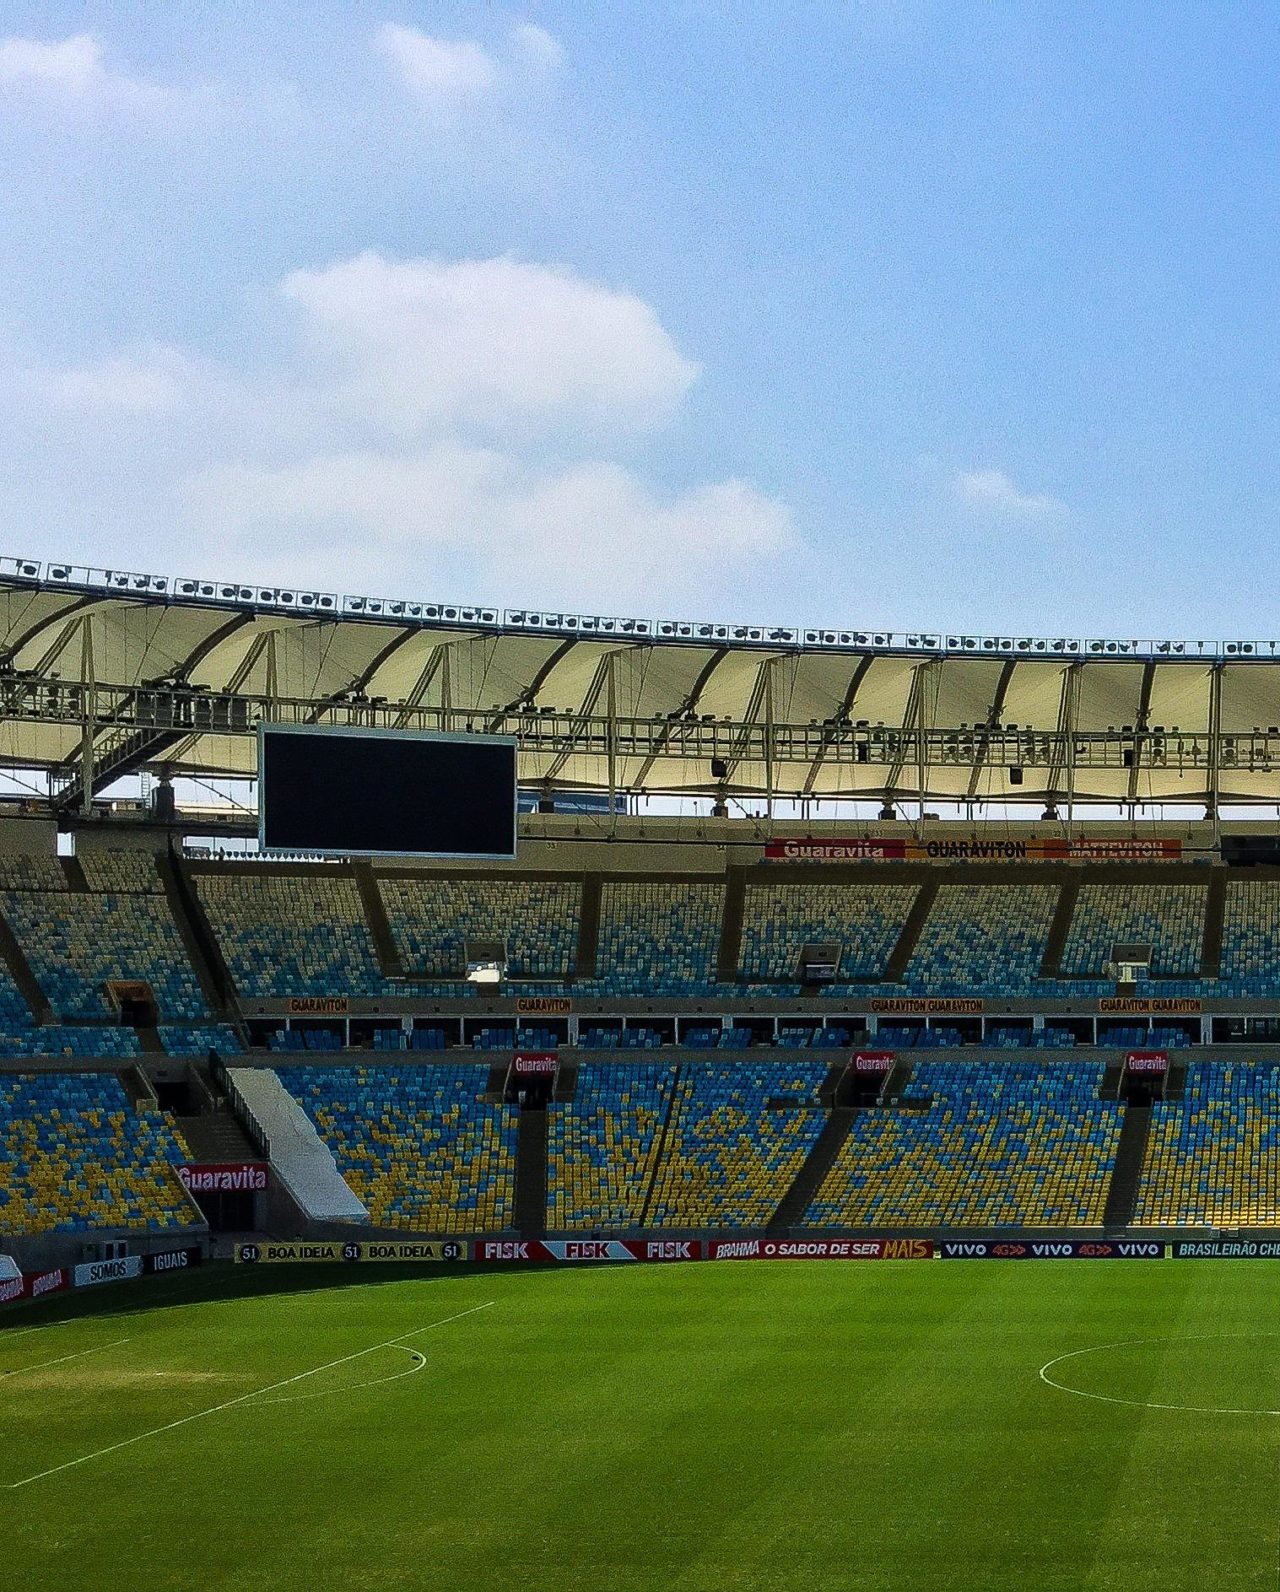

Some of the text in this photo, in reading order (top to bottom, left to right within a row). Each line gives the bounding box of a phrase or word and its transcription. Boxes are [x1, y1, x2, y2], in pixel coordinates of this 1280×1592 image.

[783, 840, 884, 858] Guaravita
[926, 840, 1026, 858] GUARAVITON
[242, 1245, 458, 1259] 51 BOA IDEIA 51 BOA IDEIA 51
[485, 1242, 691, 1259] FISK FISK FISK
[716, 1240, 928, 1259] BRAHMA O SABOR DE SER MAIS
[1178, 1241, 1257, 1256] BRASILEIRÃO
[153, 1251, 188, 1271] IGUAIS
[90, 1261, 127, 1281] SOMOS
